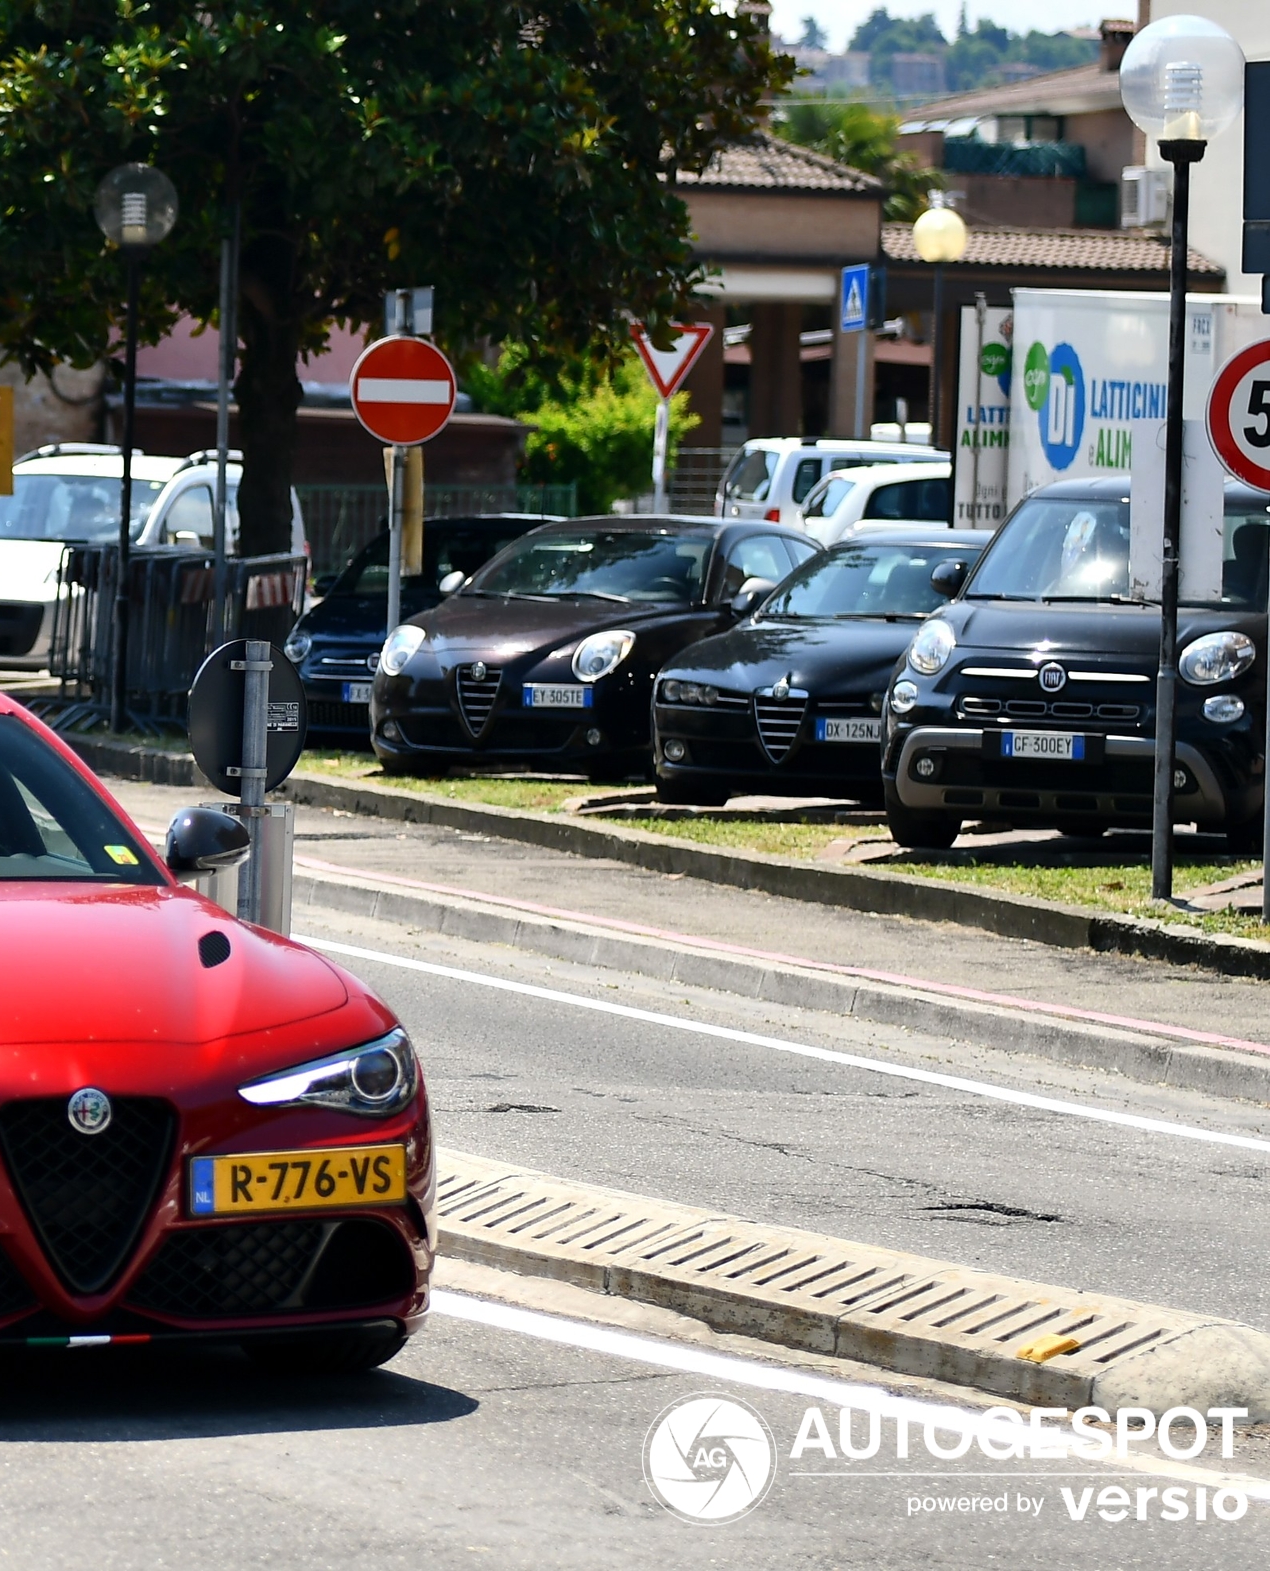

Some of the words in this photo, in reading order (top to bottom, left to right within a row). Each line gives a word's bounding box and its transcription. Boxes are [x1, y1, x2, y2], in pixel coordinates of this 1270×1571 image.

[1090, 379, 1167, 421] LATTICINI
[195, 1191, 211, 1203] NL
[231, 1156, 391, 1203] R-776-VS
